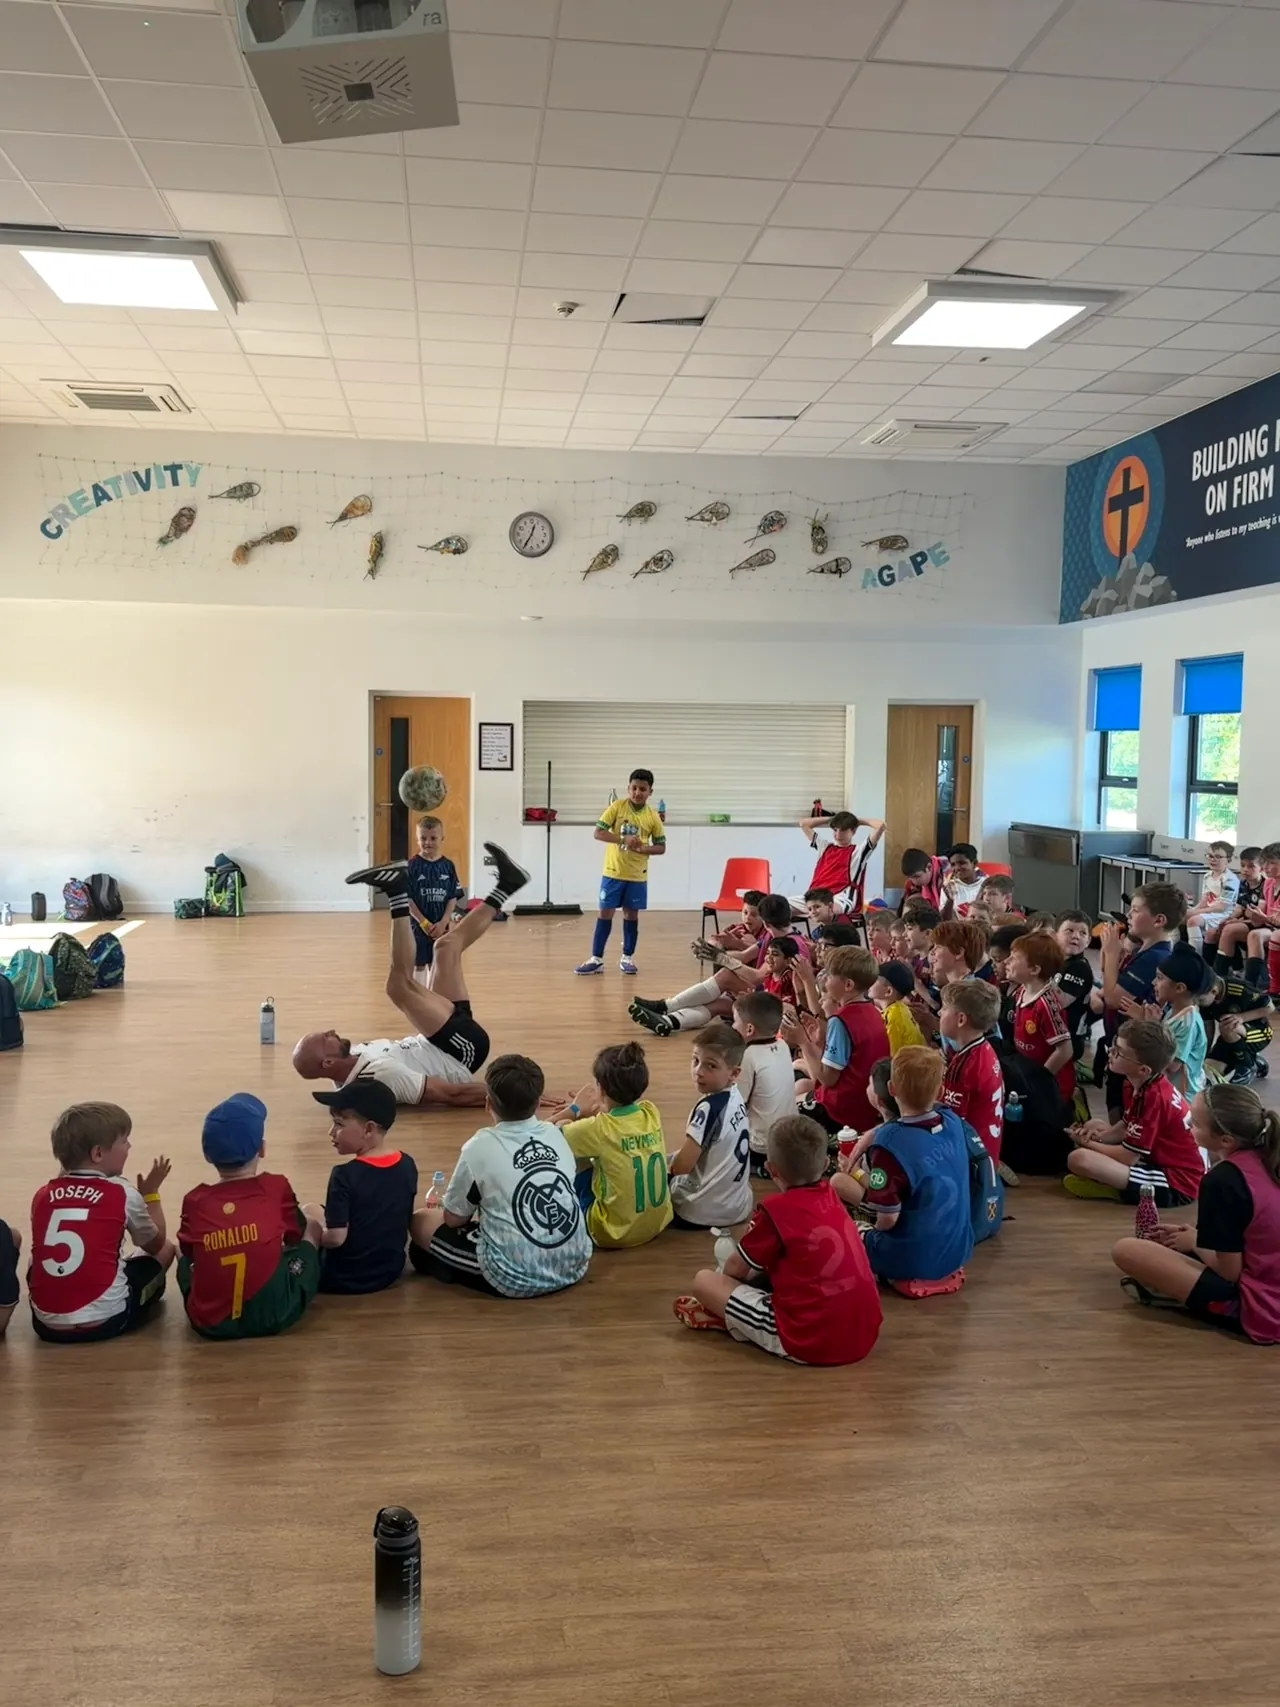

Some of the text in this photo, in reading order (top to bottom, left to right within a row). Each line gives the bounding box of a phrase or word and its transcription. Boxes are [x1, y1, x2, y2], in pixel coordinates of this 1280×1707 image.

[1192, 424, 1269, 481] BUILDING
[40, 463, 202, 540] CREATIVITY
[1205, 464, 1275, 516] ON FIRM
[1239, 524, 1248, 536] my
[1248, 516, 1272, 531] teaching
[861, 541, 951, 589] AGAPE
[733, 1129, 749, 1182] 9
[49, 1185, 104, 1204] JOSEPH
[632, 1152, 667, 1213] 10
[41, 1207, 90, 1277] 5
[203, 1223, 258, 1252] RONALDO
[220, 1252, 246, 1320] 7
